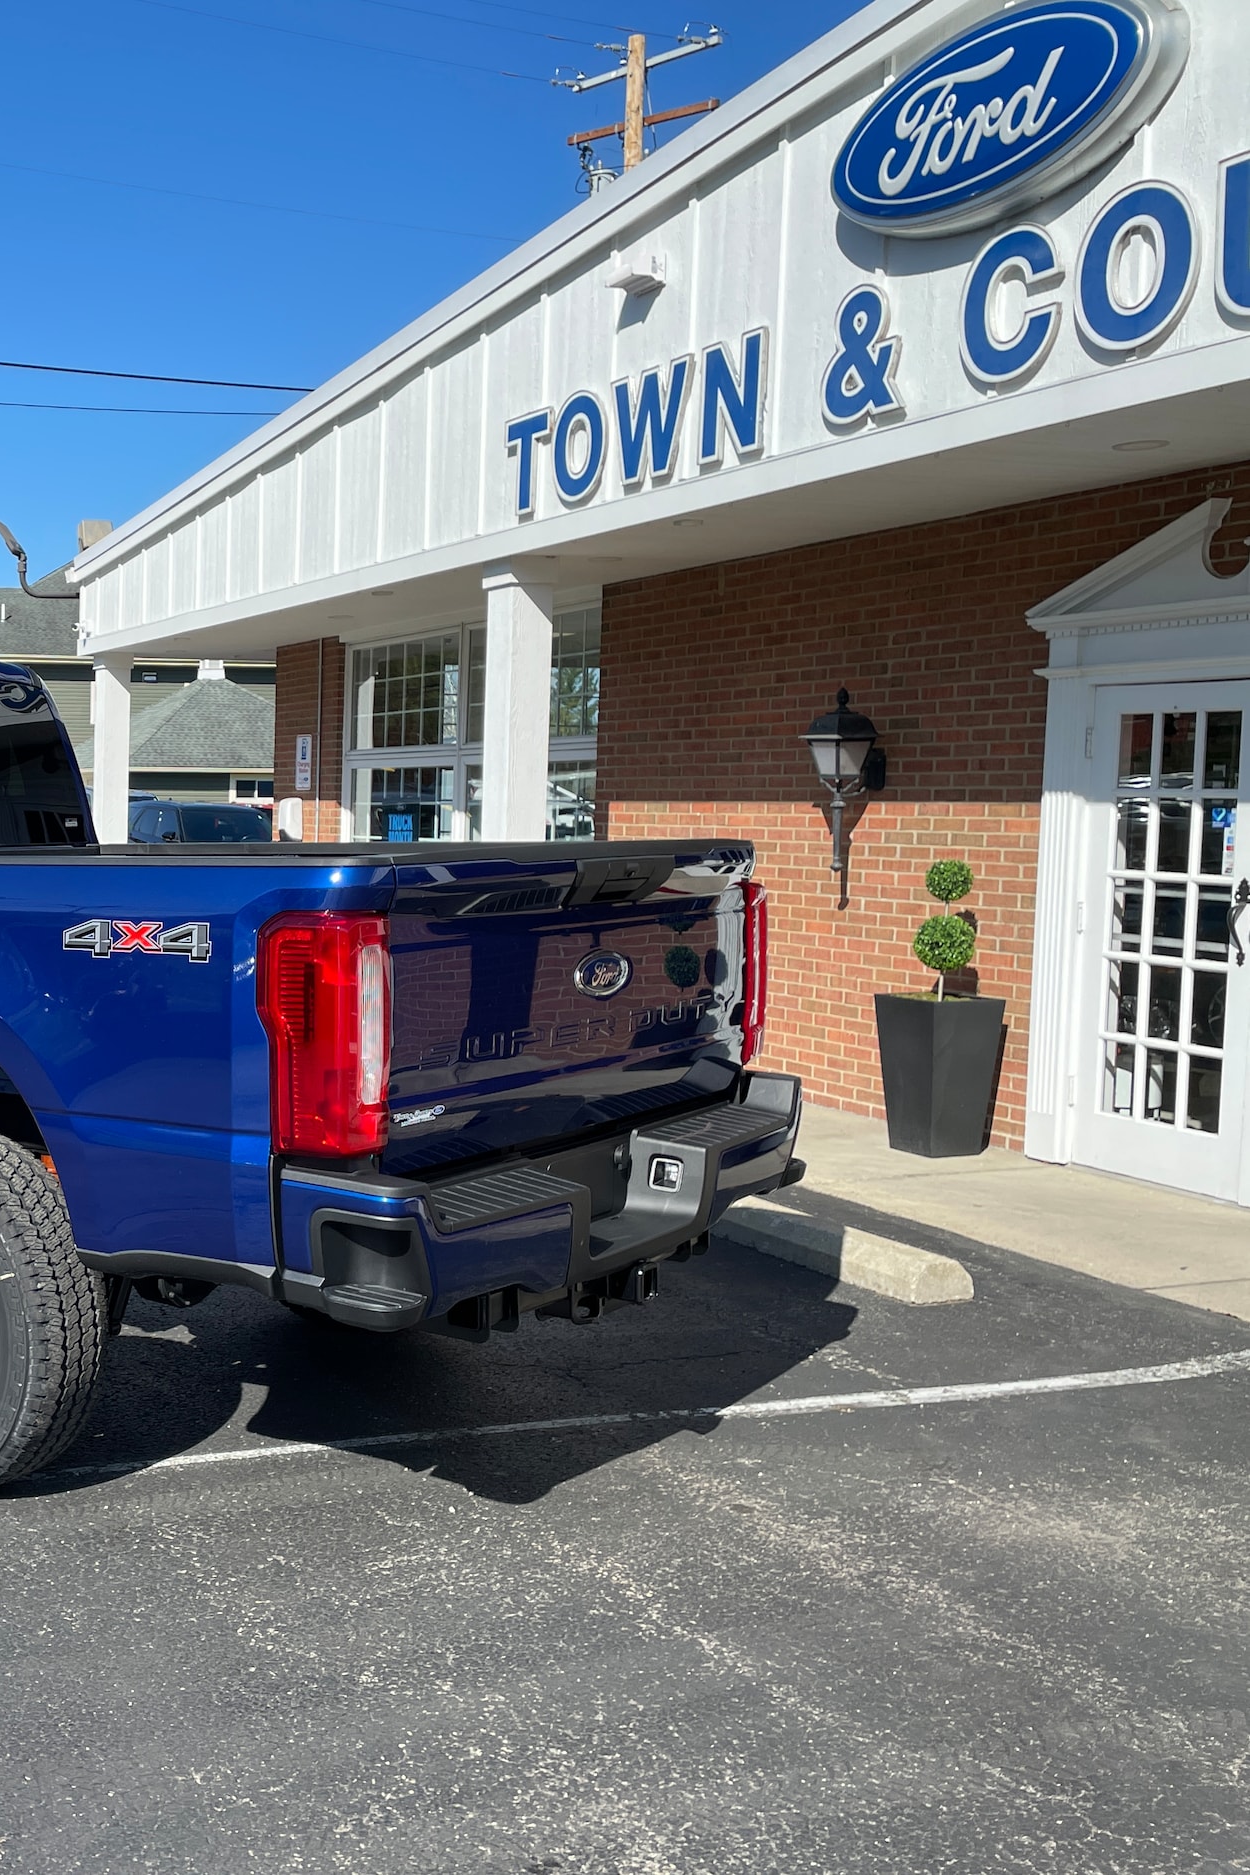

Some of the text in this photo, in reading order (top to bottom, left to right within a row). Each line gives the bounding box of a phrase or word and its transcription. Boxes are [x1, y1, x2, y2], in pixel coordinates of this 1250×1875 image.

[878, 45, 1065, 197] Ford
[505, 325, 769, 516] TOWN
[821, 284, 903, 425] &
[387, 813, 413, 831] TRUCK
[591, 961, 622, 987] Ford
[418, 990, 735, 1072] SUPER DUTY
